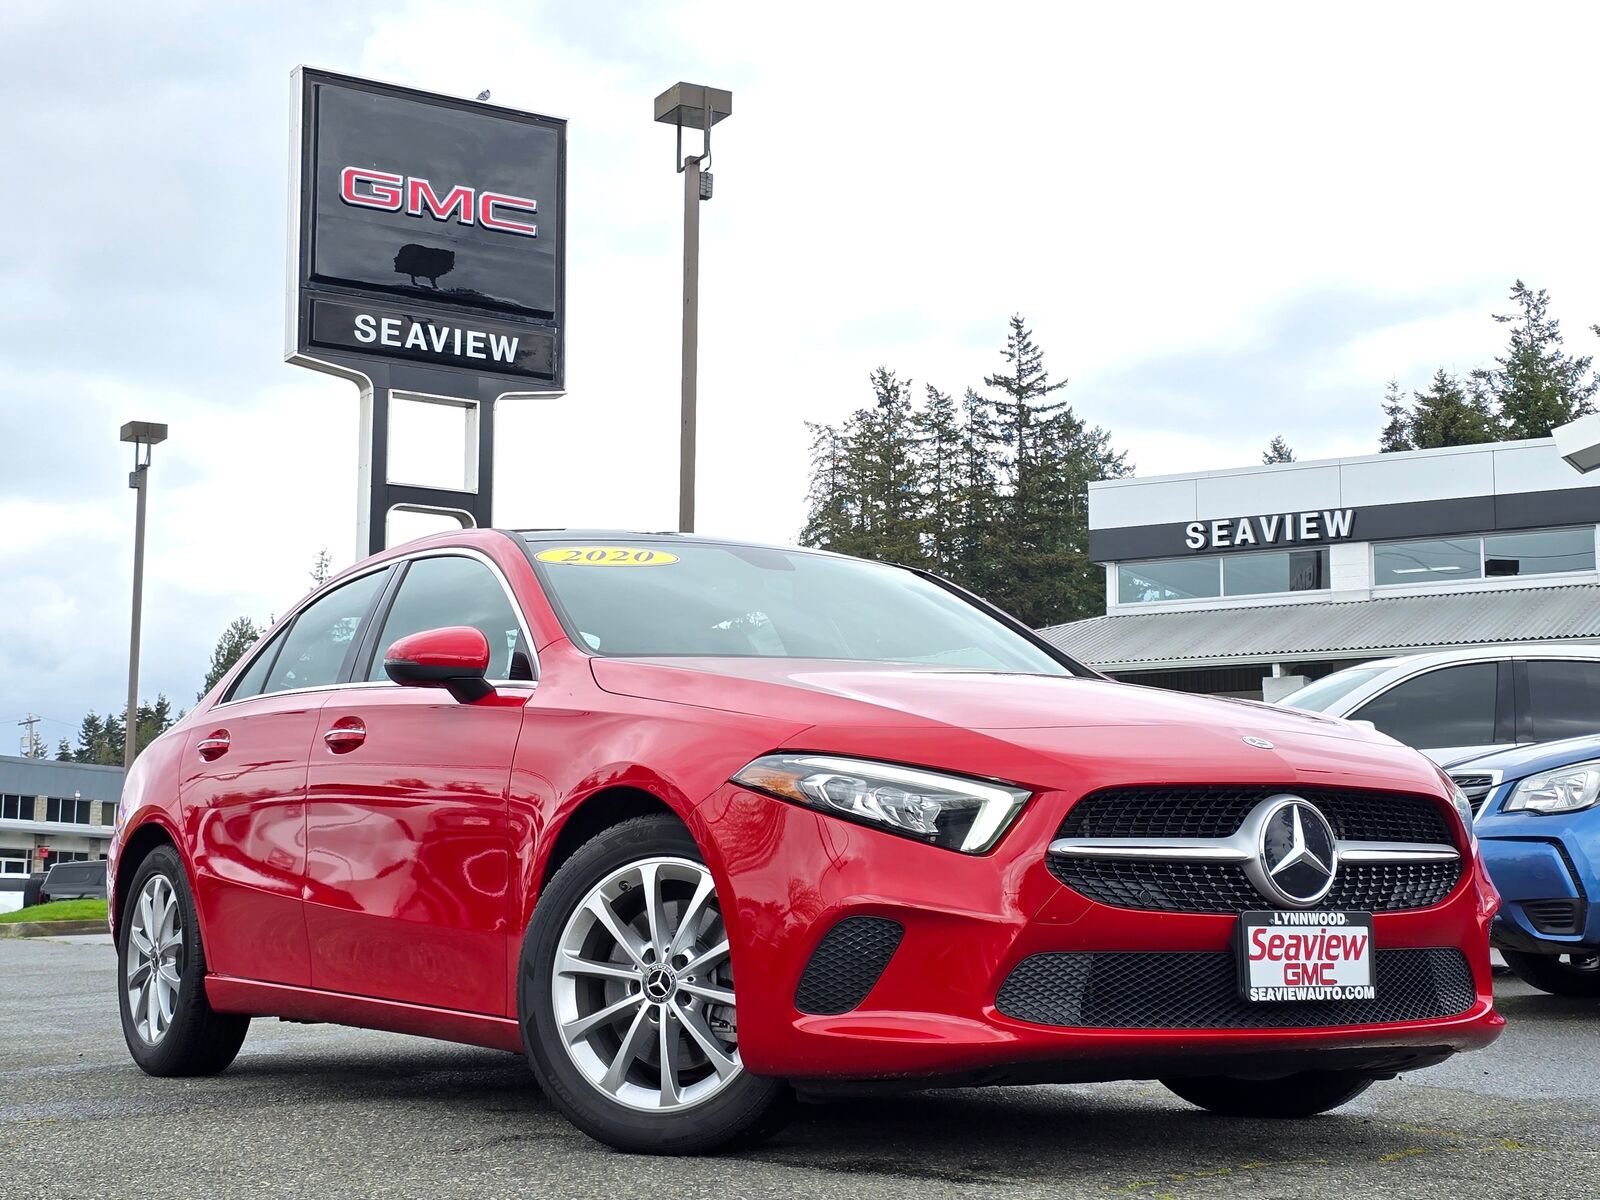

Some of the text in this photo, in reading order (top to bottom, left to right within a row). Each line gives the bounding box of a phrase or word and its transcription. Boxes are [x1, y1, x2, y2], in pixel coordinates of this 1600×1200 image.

[340, 166, 537, 236] GMC
[354, 314, 519, 363] SEAVIEW
[1185, 509, 1354, 549] SEAVIEW
[561, 550, 654, 562] 2020
[1274, 912, 1346, 926] LYNNWOOD
[1249, 928, 1368, 961] Seaview
[1283, 963, 1338, 986] GMC
[1250, 986, 1375, 1001] SEAVIEWAUTO.COM
